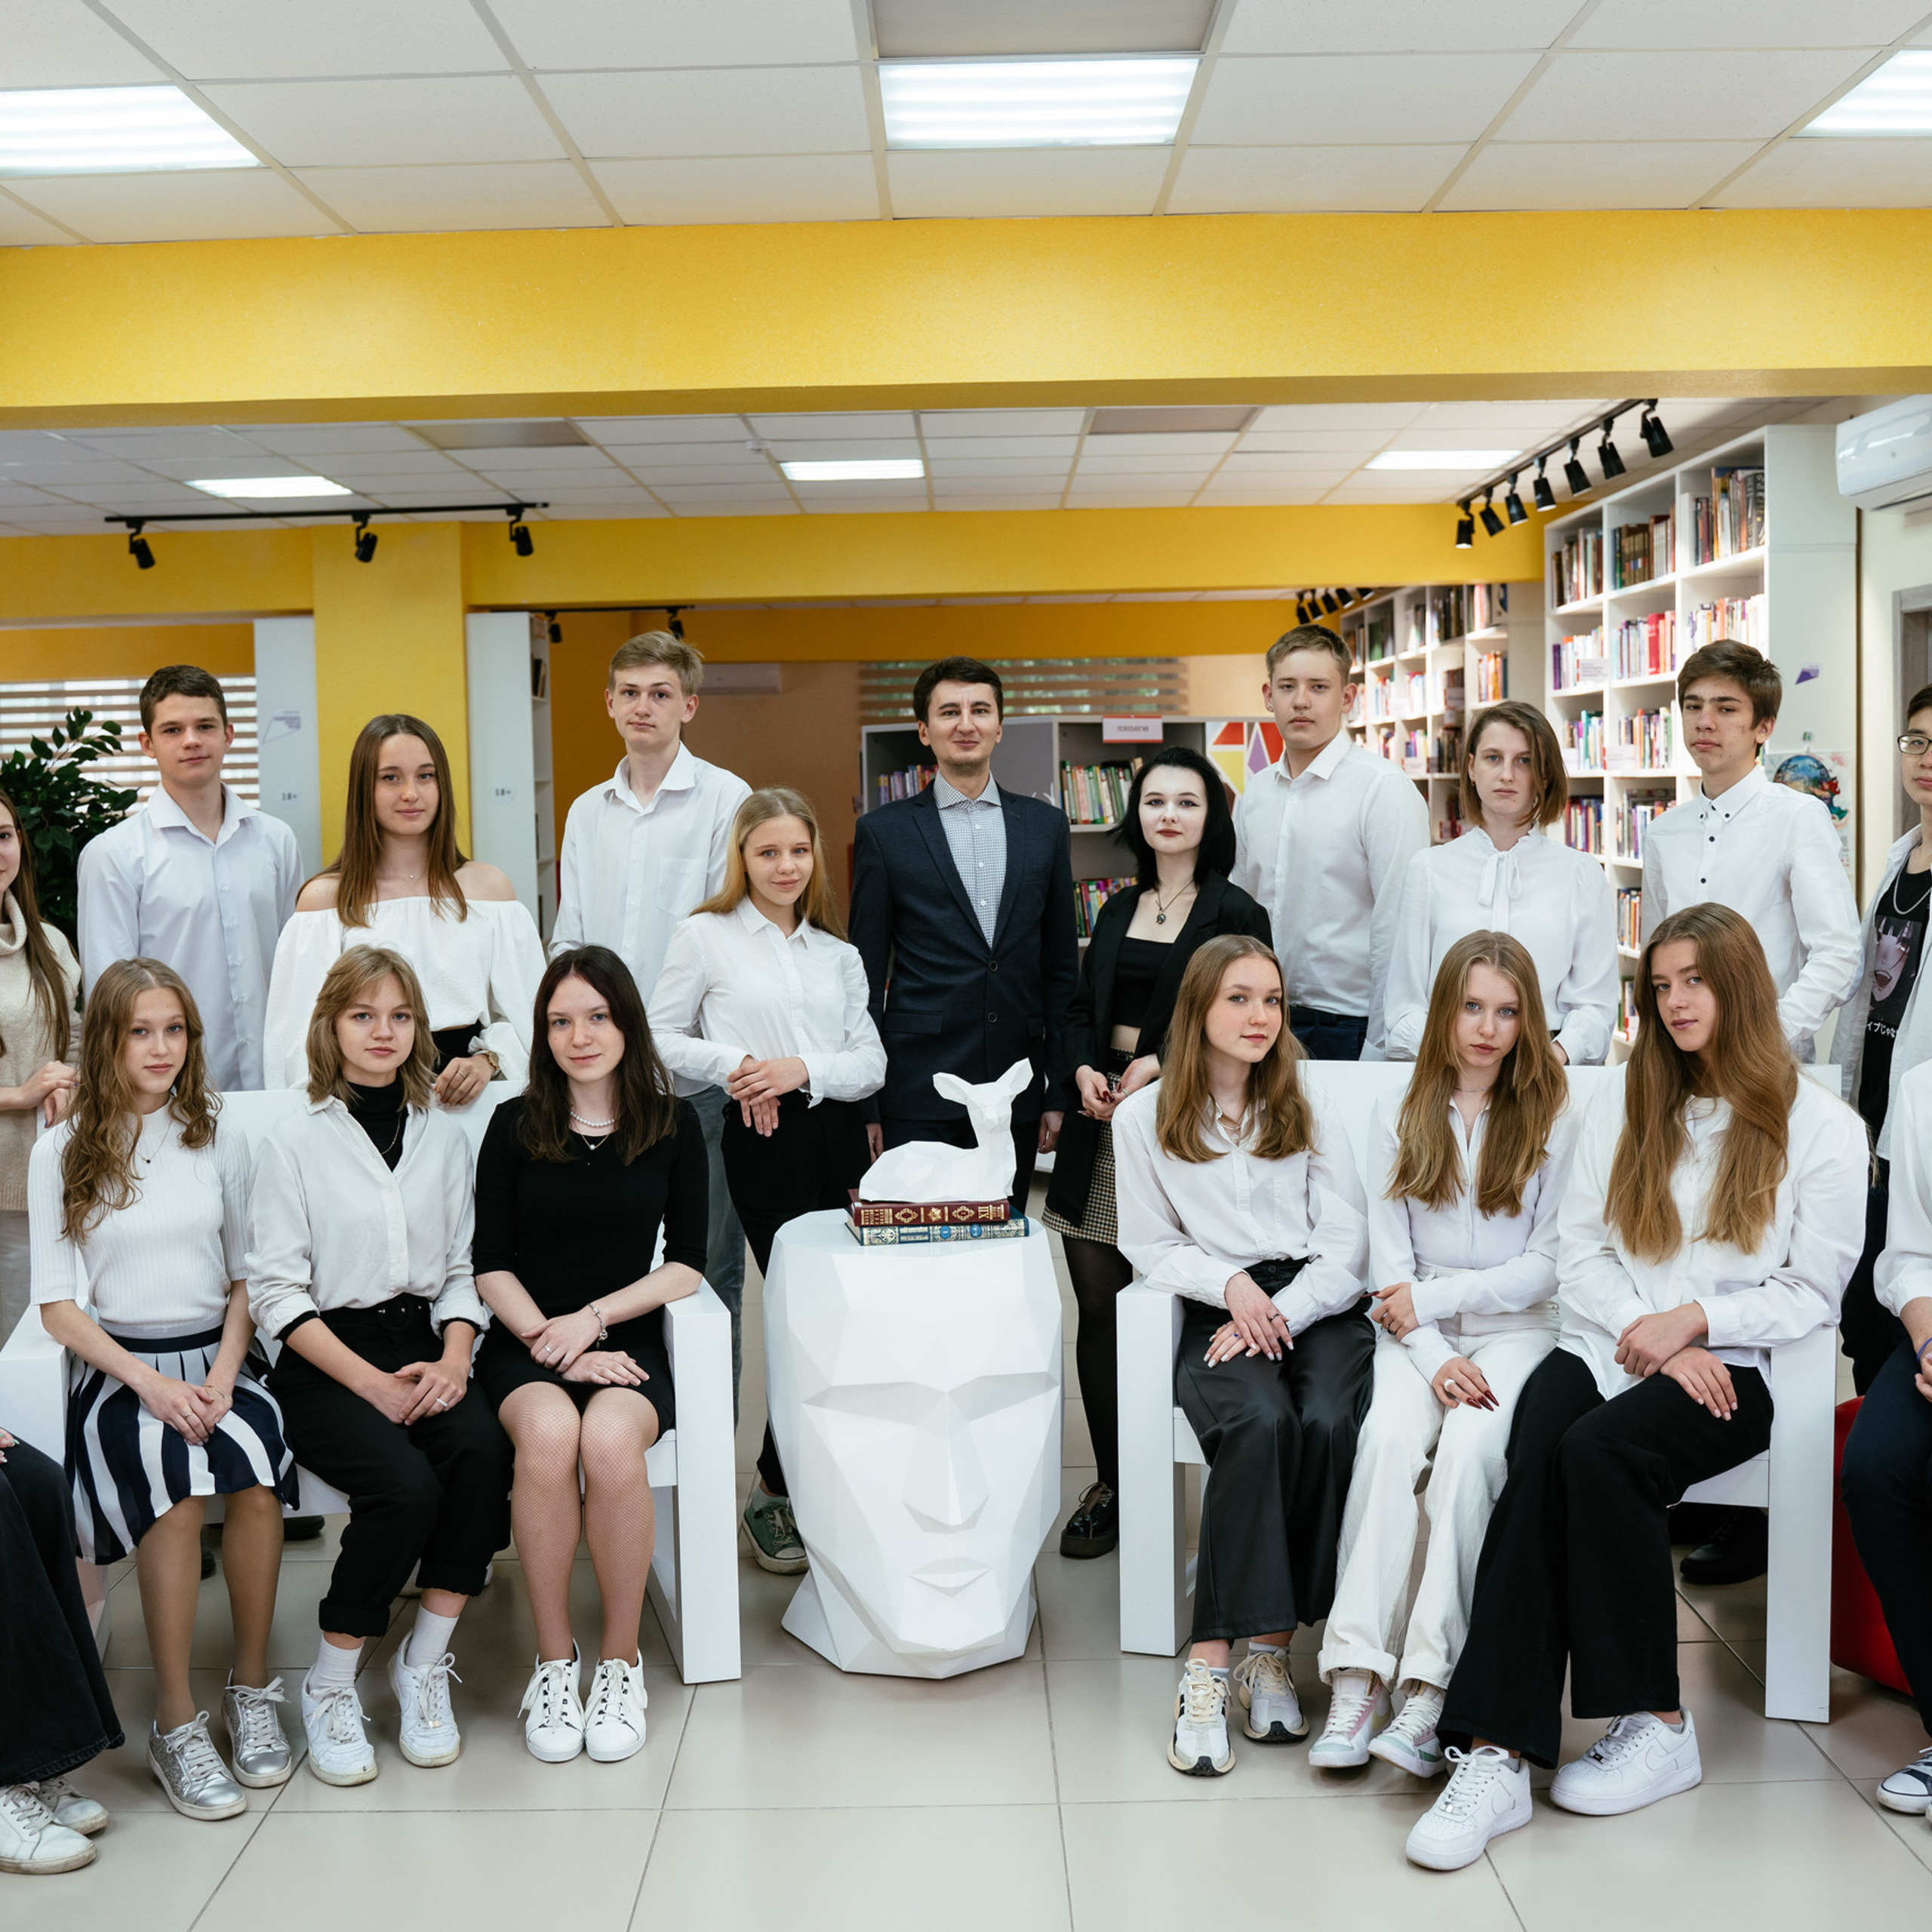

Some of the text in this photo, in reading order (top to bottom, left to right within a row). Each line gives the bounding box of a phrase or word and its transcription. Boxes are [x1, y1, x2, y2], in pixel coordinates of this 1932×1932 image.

[281, 792, 298, 801] 18+
[495, 788, 511, 797] 18+
[978, 1206, 989, 1219] XII
